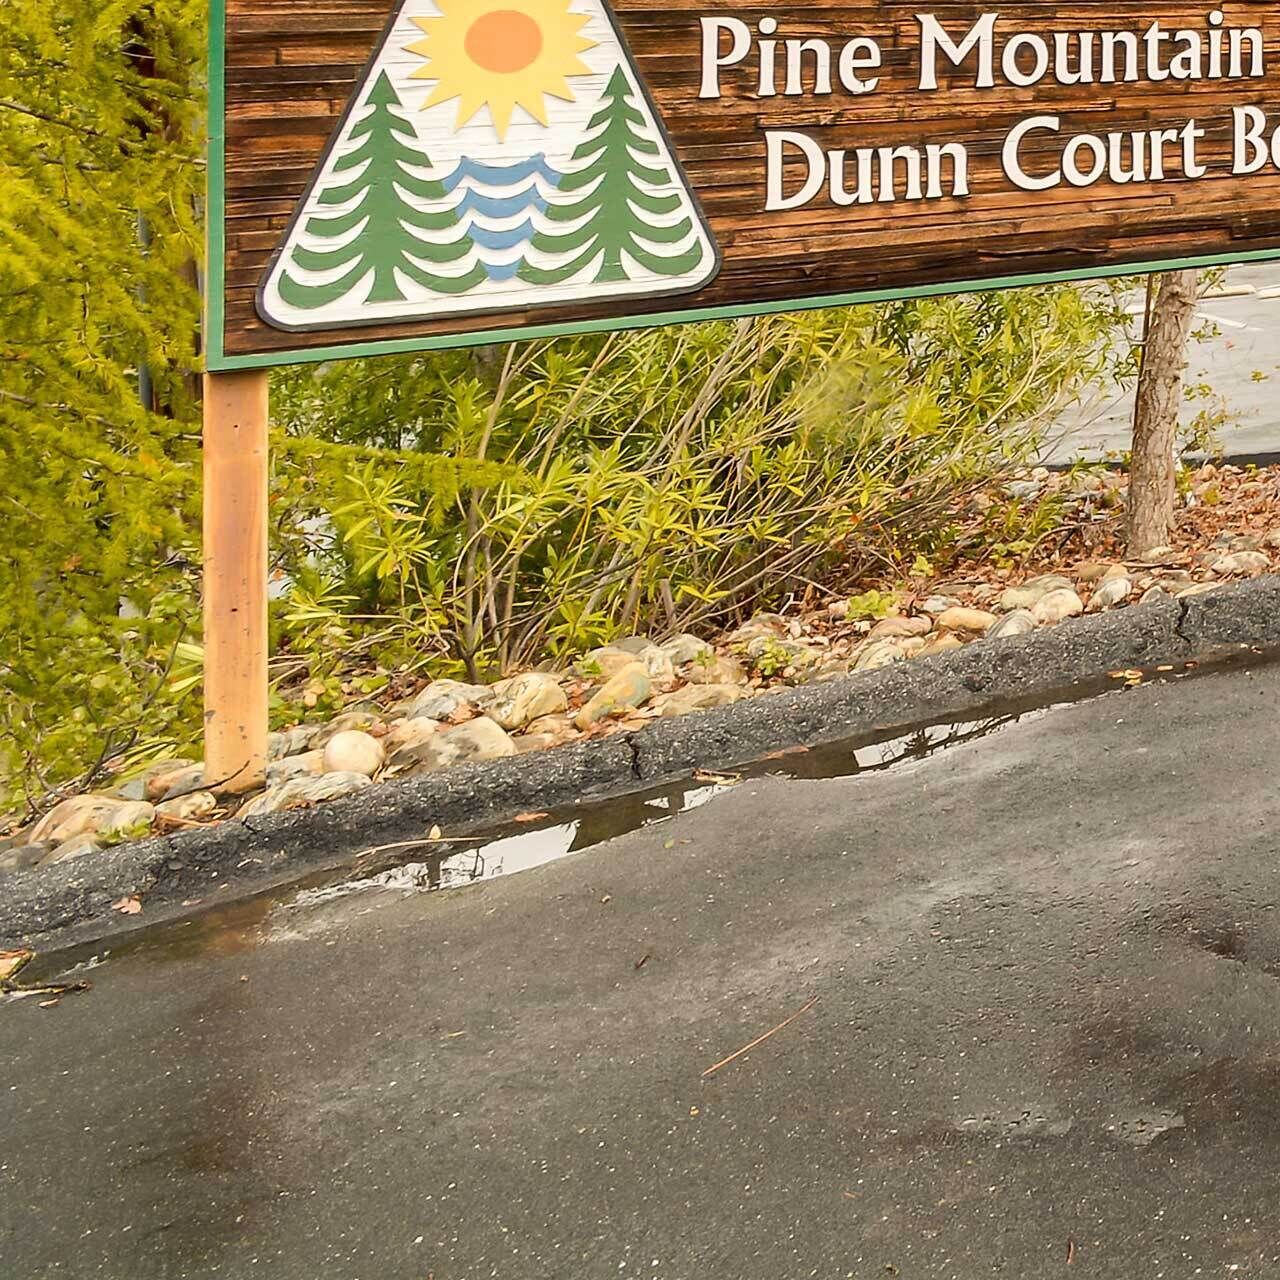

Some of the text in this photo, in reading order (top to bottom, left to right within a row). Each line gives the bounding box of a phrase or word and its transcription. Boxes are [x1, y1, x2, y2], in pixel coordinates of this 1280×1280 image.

[697, 17, 882, 98] Pine
[917, 11, 1265, 91] Mountain
[764, 131, 970, 211] Dunn
[1002, 115, 1208, 191] Court
